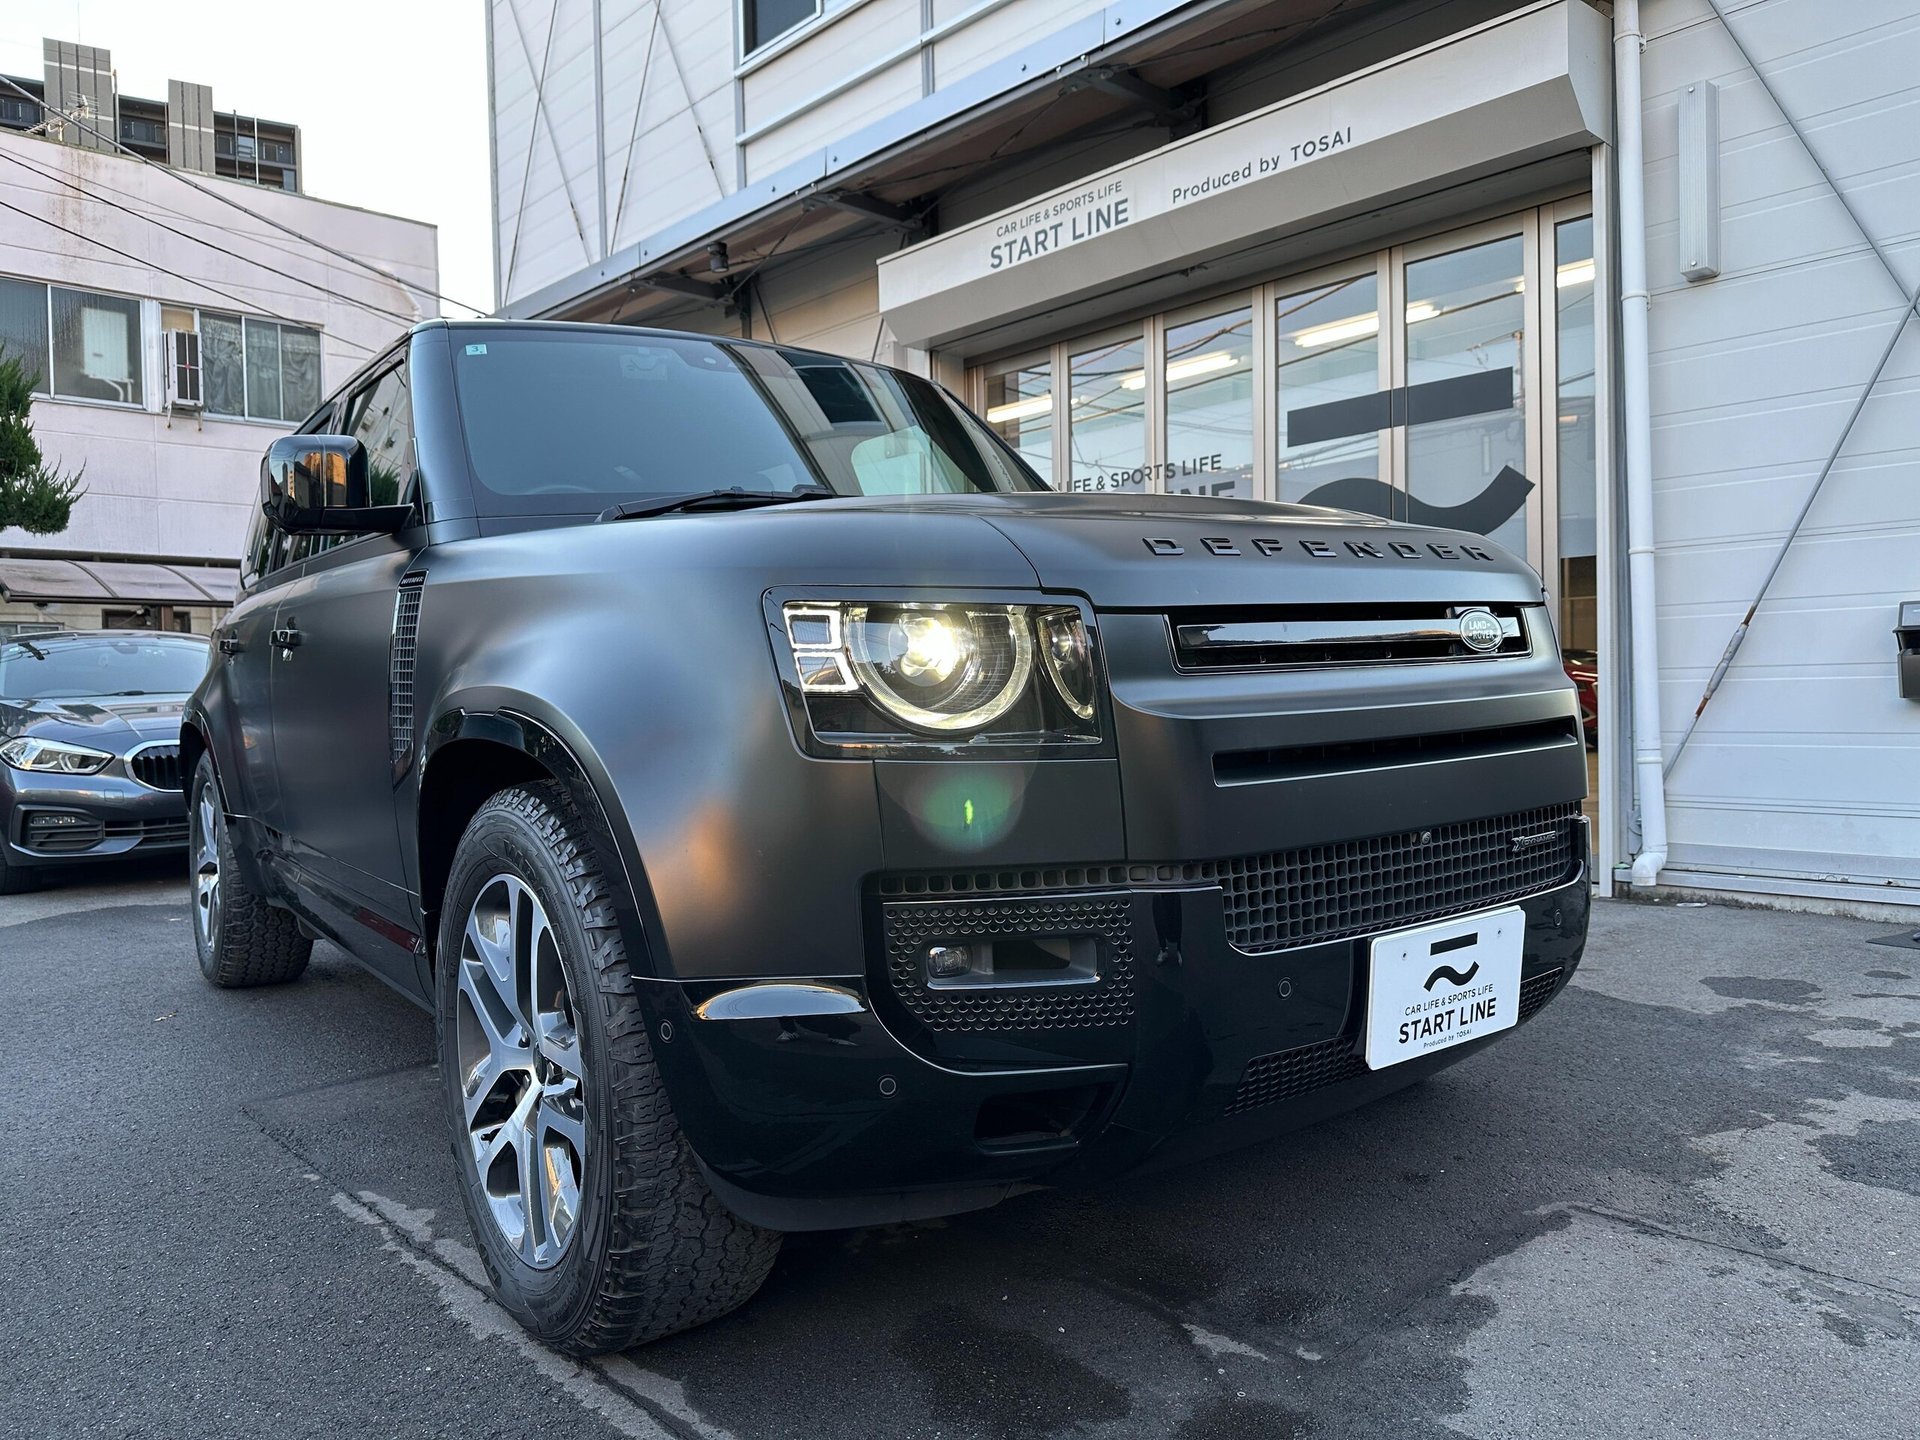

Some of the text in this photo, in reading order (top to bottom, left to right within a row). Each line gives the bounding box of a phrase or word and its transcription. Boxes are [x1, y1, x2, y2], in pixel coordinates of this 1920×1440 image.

[1172, 126, 1351, 203] Produced by TOSAI
[996, 181, 1123, 238] CAR LIFE & SPORTS LIFE
[990, 197, 1129, 269] START LINE
[1096, 475, 1105, 491] &
[1110, 462, 1176, 489] SPORTS
[1182, 453, 1222, 477] LIFE
[1142, 537, 1495, 561] DEFENDER
[1469, 620, 1487, 630] LAND
[1472, 629, 1495, 640] ROVER
[1404, 983, 1494, 1016] CAR LIFE & SPORTS LIFE
[1398, 996, 1497, 1044] START LINE
[1423, 1037, 1447, 1048] Produced
[1456, 1028, 1472, 1039] TOSAI
